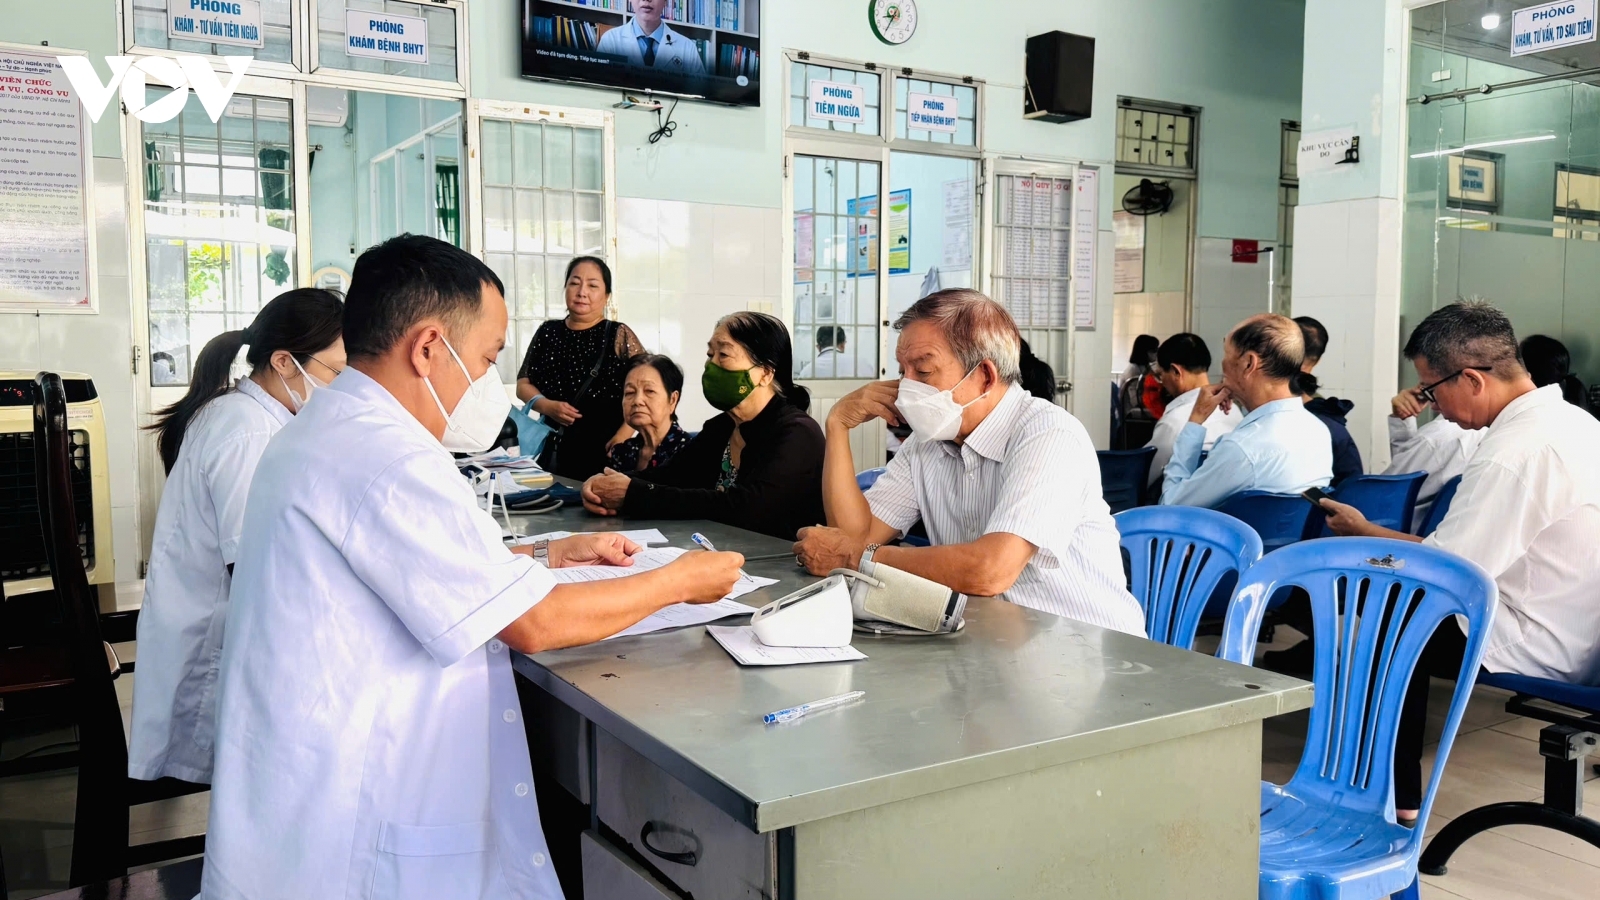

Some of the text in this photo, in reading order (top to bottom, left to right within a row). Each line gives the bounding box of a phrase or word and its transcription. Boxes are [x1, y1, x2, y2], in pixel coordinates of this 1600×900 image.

[1532, 5, 1575, 21] PHÒNG
[174, 15, 194, 33] KHÁM
[200, 19, 208, 34] TƯ
[210, 17, 222, 36] VẤN
[224, 21, 239, 38] TIÊM
[241, 23, 258, 40] NGỪA
[370, 19, 404, 34] PHÒNG
[1515, 30, 1532, 47] KHÁM,
[1534, 28, 1541, 43] TƯ
[1556, 26, 1563, 39] TD
[1565, 23, 1576, 38] SAU
[1578, 17, 1592, 35] TIÊM
[350, 35, 423, 55] KHÁM BỆNH BHYT
[27, 87, 53, 95] CÔNG
[823, 86, 852, 99] PHÒNG
[815, 101, 860, 118] TIÊM NGỪA
[923, 100, 944, 111] PHÒNG
[911, 111, 920, 122] TIẾP
[945, 117, 955, 126] BHYT
